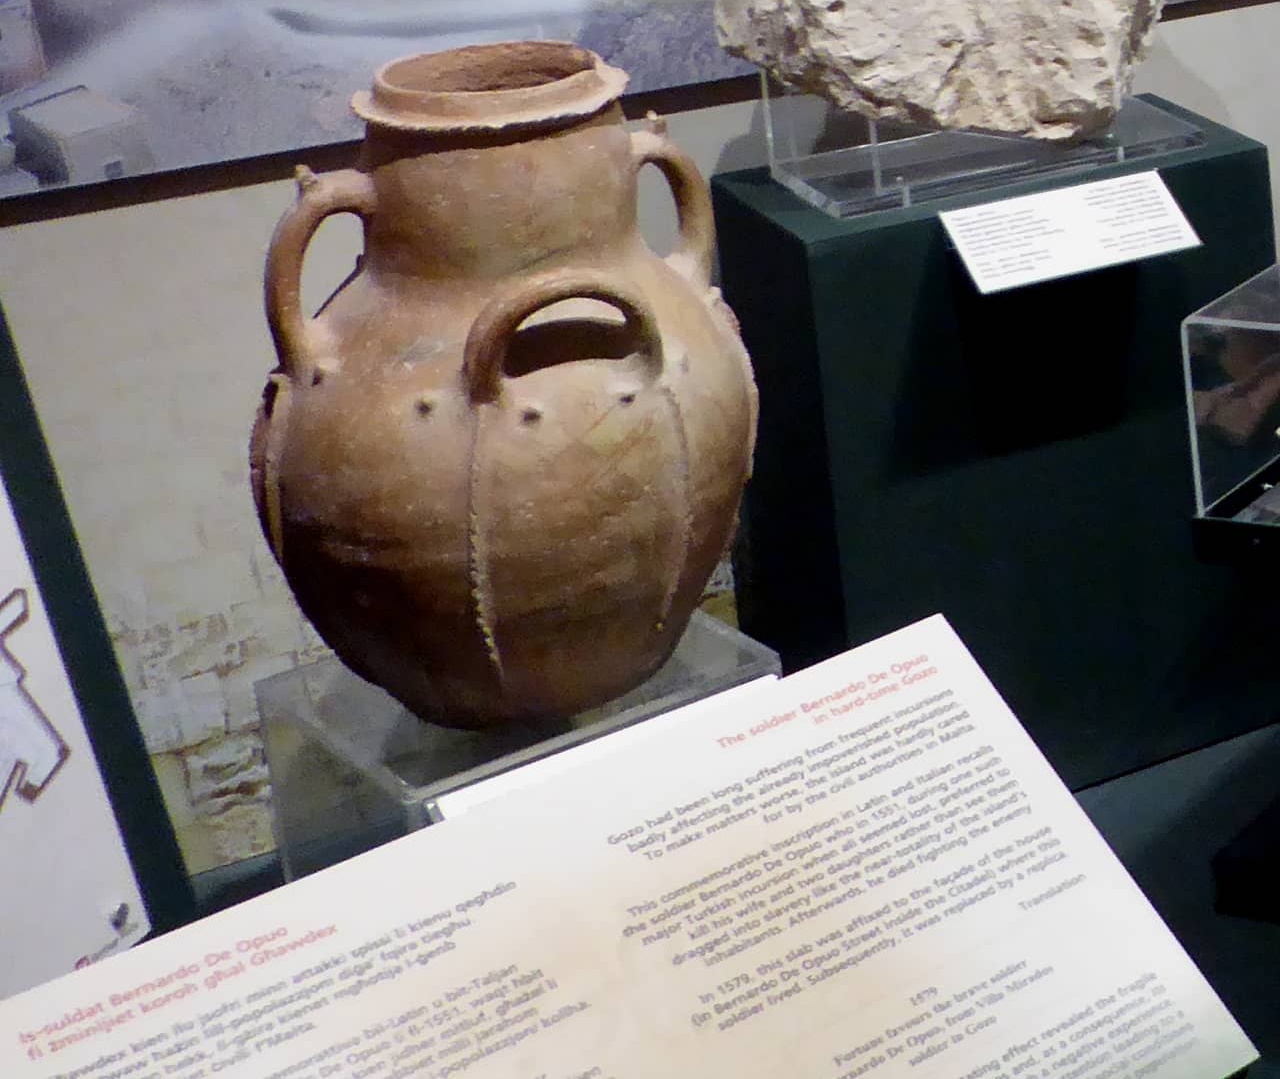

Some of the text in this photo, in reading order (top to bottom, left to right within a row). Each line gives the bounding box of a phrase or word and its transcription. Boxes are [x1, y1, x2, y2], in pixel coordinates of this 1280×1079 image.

[606, 688, 953, 845] Gozo had been long suffering from frequent incursions
[716, 654, 928, 748] The soldier Bernardo De Opuo
[813, 666, 937, 724] in hard-time Gozo
[621, 921, 647, 937] the
[649, 898, 696, 925] soldier
[697, 868, 762, 902] Bernardo
[762, 858, 783, 872] De
[784, 840, 822, 861] Opuo
[824, 825, 854, 843] who
[855, 818, 869, 829] in
[906, 781, 949, 805] during
[949, 769, 972, 785] one
[973, 756, 1001, 773] such
[626, 831, 666, 853] badly
[669, 803, 731, 834] affecting
[731, 792, 755, 806] the
[758, 770, 805, 796] already
[806, 729, 891, 773] impoverished
[626, 744, 994, 917] This commemorative inscription in Latin and Italian recalls
[641, 921, 682, 945] major
[683, 897, 736, 924] Turkish
[737, 867, 800, 901] incursion
[800, 848, 839, 870] when
[858, 814, 908, 844] seemed
[938, 772, 995, 807] preferred
[995, 767, 1010, 777] to
[642, 848, 663, 860] To
[665, 831, 703, 851] make
[705, 806, 757, 834] matters
[804, 775, 827, 789] the
[828, 755, 867, 778] island
[869, 744, 895, 760] was
[894, 726, 935, 747] hardly
[936, 709, 970, 729] cared
[710, 915, 733, 929] his
[734, 899, 766, 918] wife
[769, 883, 795, 903] and
[796, 872, 824, 889] two
[826, 840, 892, 875] daughters
[893, 820, 931, 843] rather
[932, 805, 964, 823] than
[963, 795, 986, 809] see
[985, 779, 1018, 797] them
[762, 810, 783, 823] for
[784, 802, 802, 814] by
[803, 790, 827, 805] the
[829, 776, 855, 794] civil
[857, 747, 924, 781] authorities
[924, 740, 938, 749] in
[671, 790, 1027, 965] dragged into slavery like the near-totality of the island's
[698, 992, 715, 1004] In
[755, 958, 784, 975] this
[784, 943, 813, 962] slab
[815, 929, 843, 947] was
[844, 903, 892, 933] affixed
[891, 897, 909, 908] to
[908, 885, 931, 900] the
[932, 864, 974, 888] façade
[976, 853, 991, 867] of
[991, 844, 1014, 859] the
[1014, 826, 1051, 847] house
[712, 978, 778, 1015] Bernardo
[778, 968, 800, 982] De
[801, 947, 840, 970] Opuo
[840, 925, 883, 952] Street
[882, 906, 922, 930] inside
[923, 894, 946, 909] the
[997, 850, 1036, 872] where
[1036, 838, 1060, 851] this
[788, 886, 866, 927] Afterwards,
[865, 875, 885, 887] he
[886, 858, 916, 878] died
[915, 835, 968, 864] fighting
[967, 824, 990, 838] the
[991, 804, 1031, 827] enemy
[1017, 873, 1086, 910] Translation
[717, 1001, 764, 1031] soldier
[765, 981, 803, 1005] lived.
[805, 937, 901, 985] Subsequently,
[900, 927, 914, 938] it
[914, 913, 941, 931] was
[942, 884, 996, 917] replaced
[995, 878, 1014, 889] by
[1016, 872, 1024, 880] a
